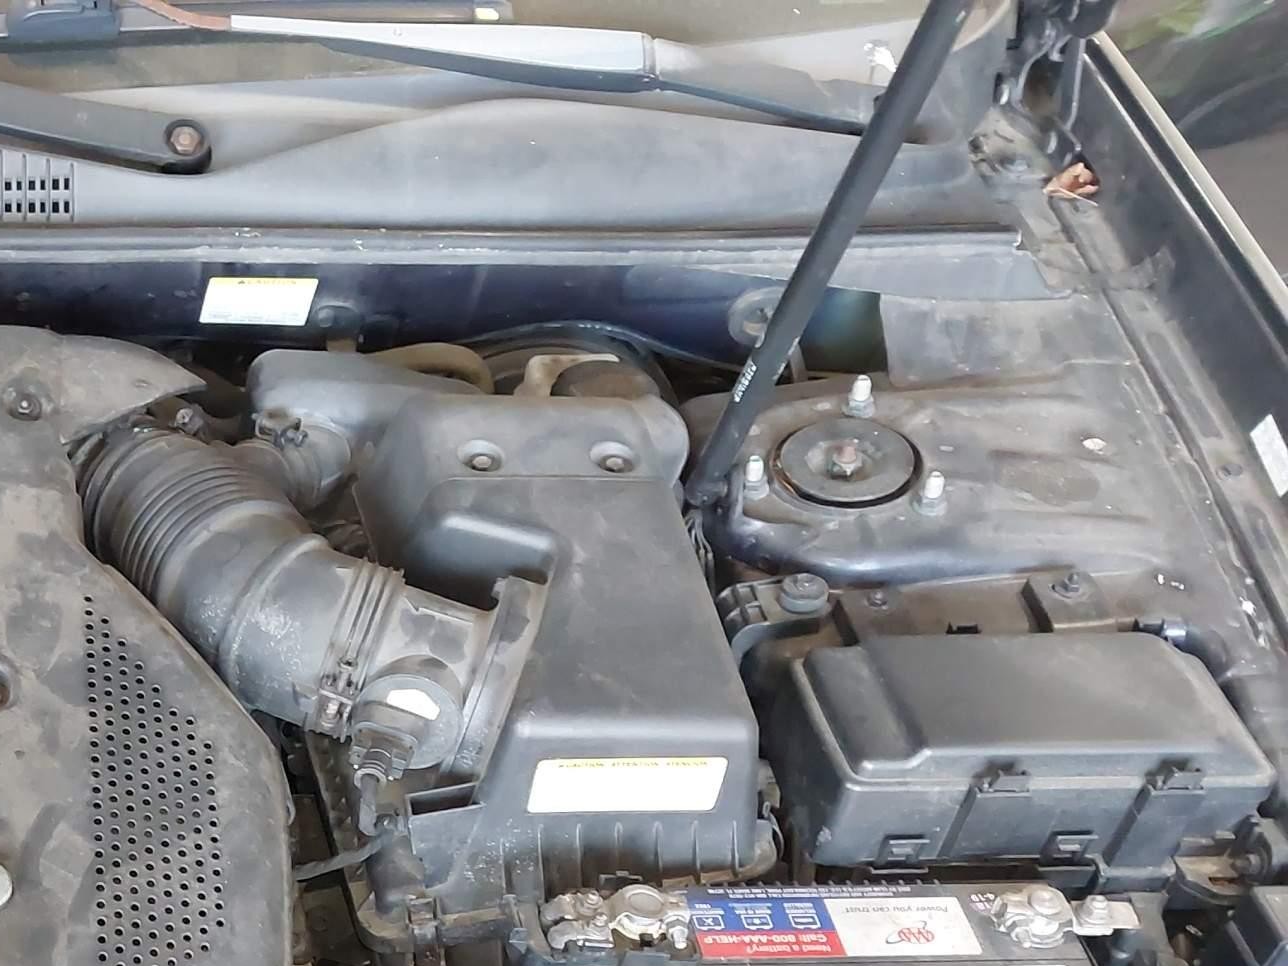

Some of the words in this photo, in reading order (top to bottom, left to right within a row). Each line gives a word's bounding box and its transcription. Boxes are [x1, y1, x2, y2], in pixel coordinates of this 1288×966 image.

[845, 905, 870, 913] trust
[892, 904, 913, 913] you
[916, 905, 948, 914] Power
[703, 934, 797, 945] 800-AAA-HELP
[798, 934, 828, 943] Call:
[746, 944, 791, 955] battery?
[802, 944, 831, 953] Need
